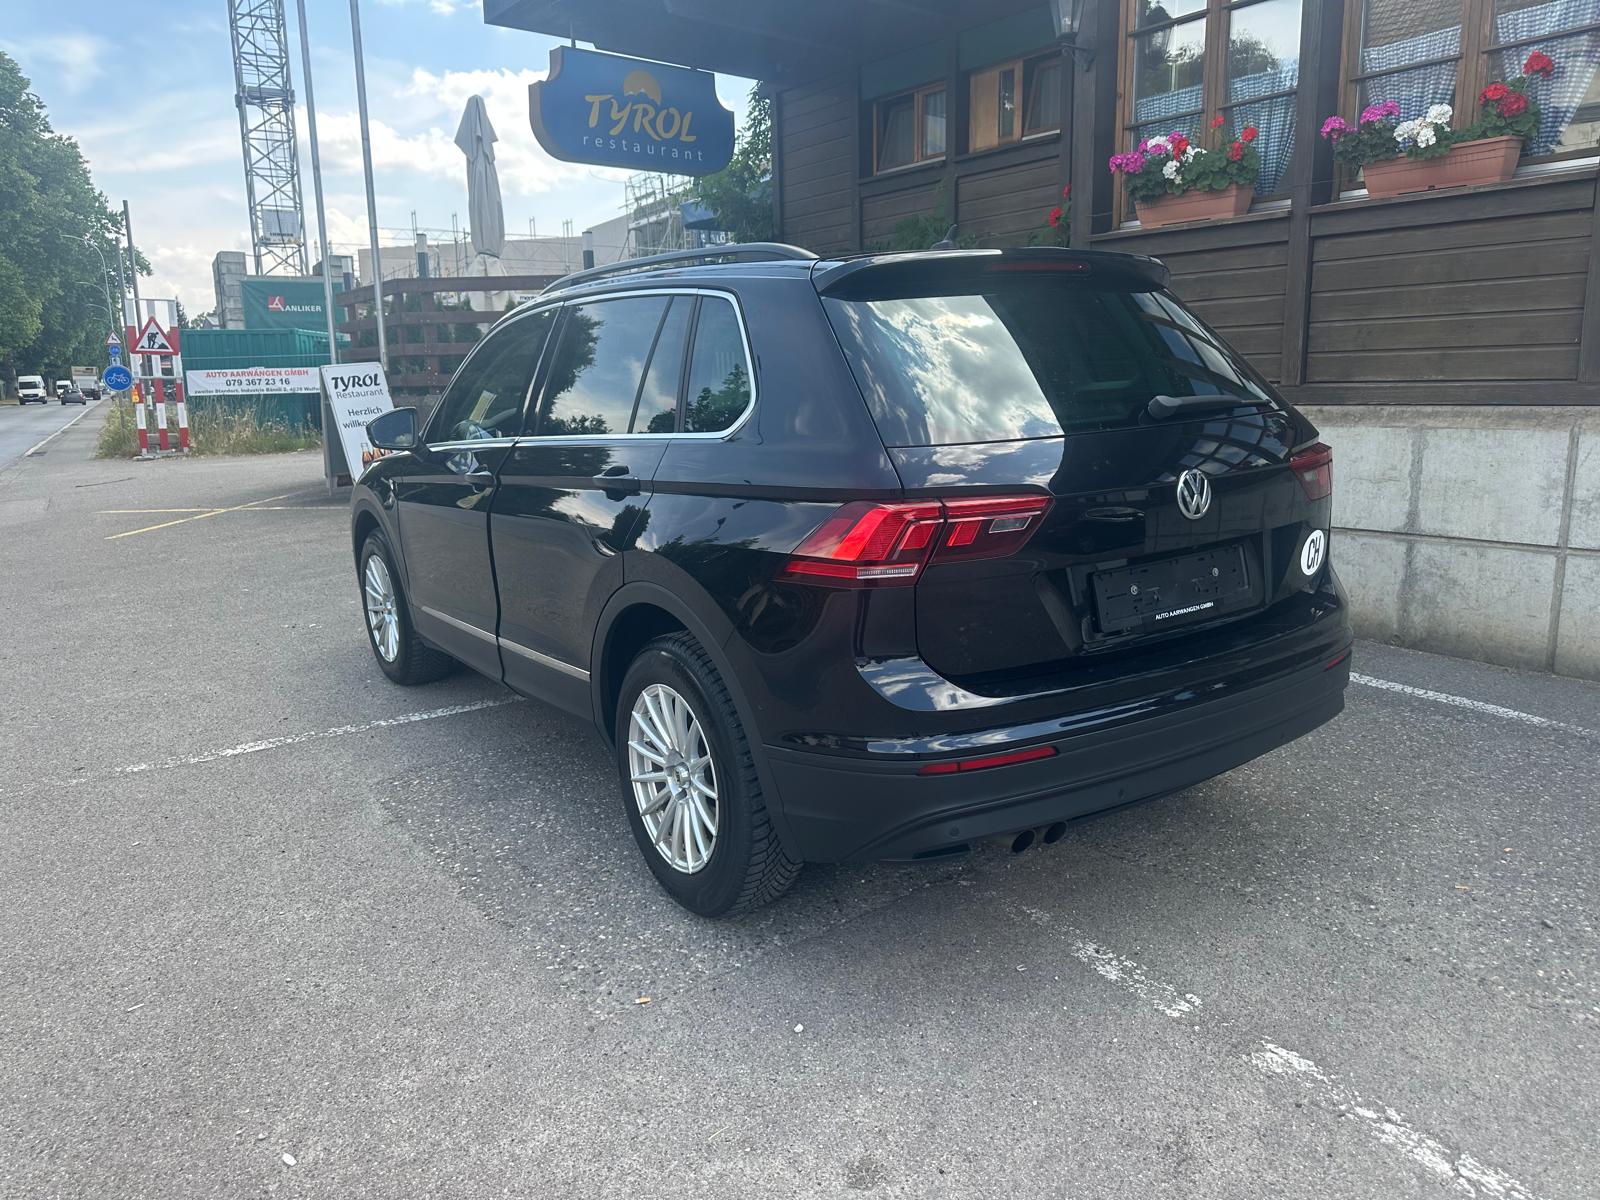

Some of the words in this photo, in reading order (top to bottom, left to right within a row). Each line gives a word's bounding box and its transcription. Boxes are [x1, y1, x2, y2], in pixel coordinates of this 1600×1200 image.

[585, 94, 697, 142] TYROL
[583, 135, 703, 161] restaurant
[206, 370, 228, 378] AUTO
[230, 369, 282, 377] AARWANGEN
[246, 378, 261, 386] 367
[331, 373, 381, 392] TYROL
[336, 388, 384, 399] Restaurant
[347, 406, 383, 416] Herzlich
[343, 419, 369, 429] willko
[1307, 535, 1321, 569] CH
[1155, 612, 1169, 620] AUTO
